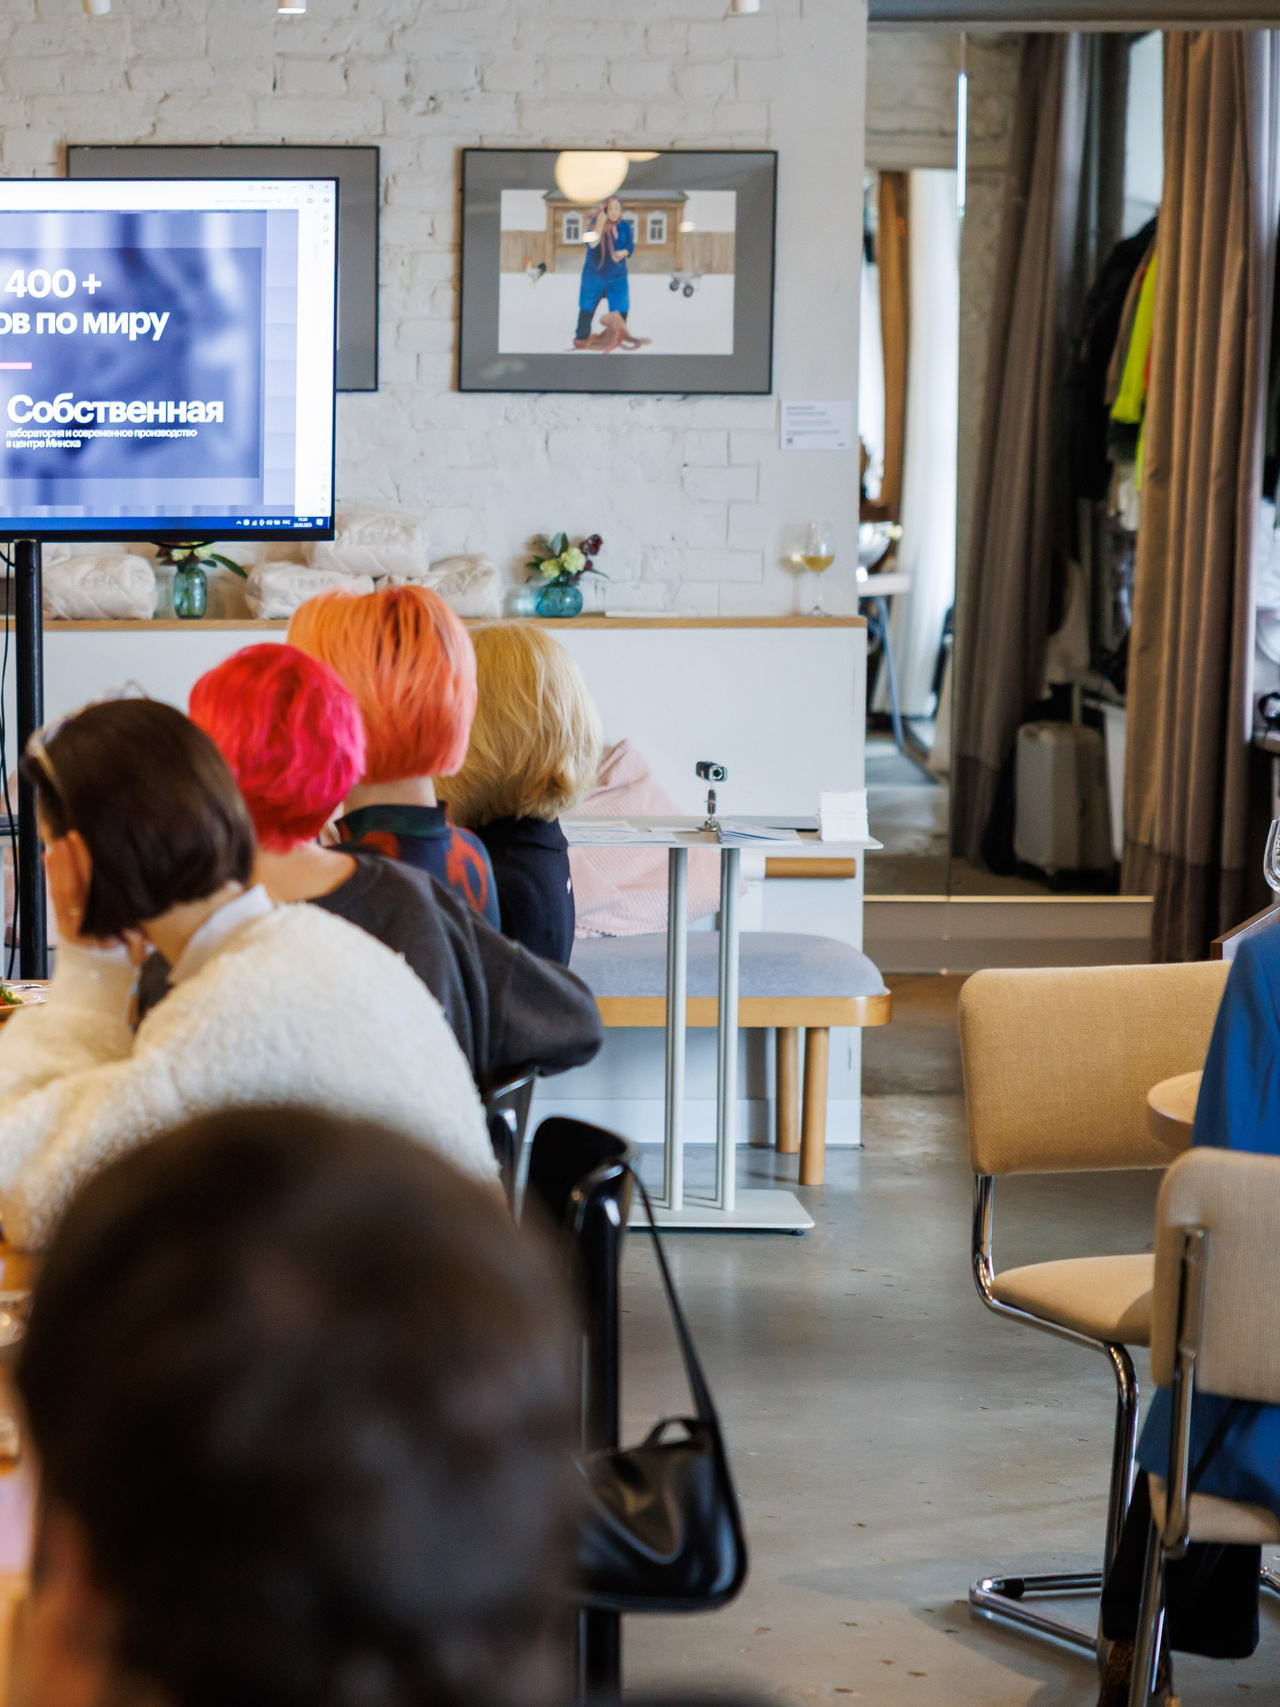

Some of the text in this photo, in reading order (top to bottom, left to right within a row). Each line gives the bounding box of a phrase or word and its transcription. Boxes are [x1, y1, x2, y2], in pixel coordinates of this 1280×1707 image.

[3, 269, 77, 298] 400
[82, 273, 102, 295] +
[36, 312, 78, 335] по
[83, 312, 170, 341] миру
[6, 392, 224, 424] Собственная
[6, 428, 64, 439] лаборатория
[65, 429, 72, 437] и
[73, 429, 134, 439] современное
[12, 440, 45, 450] центре
[46, 439, 81, 448] Минска
